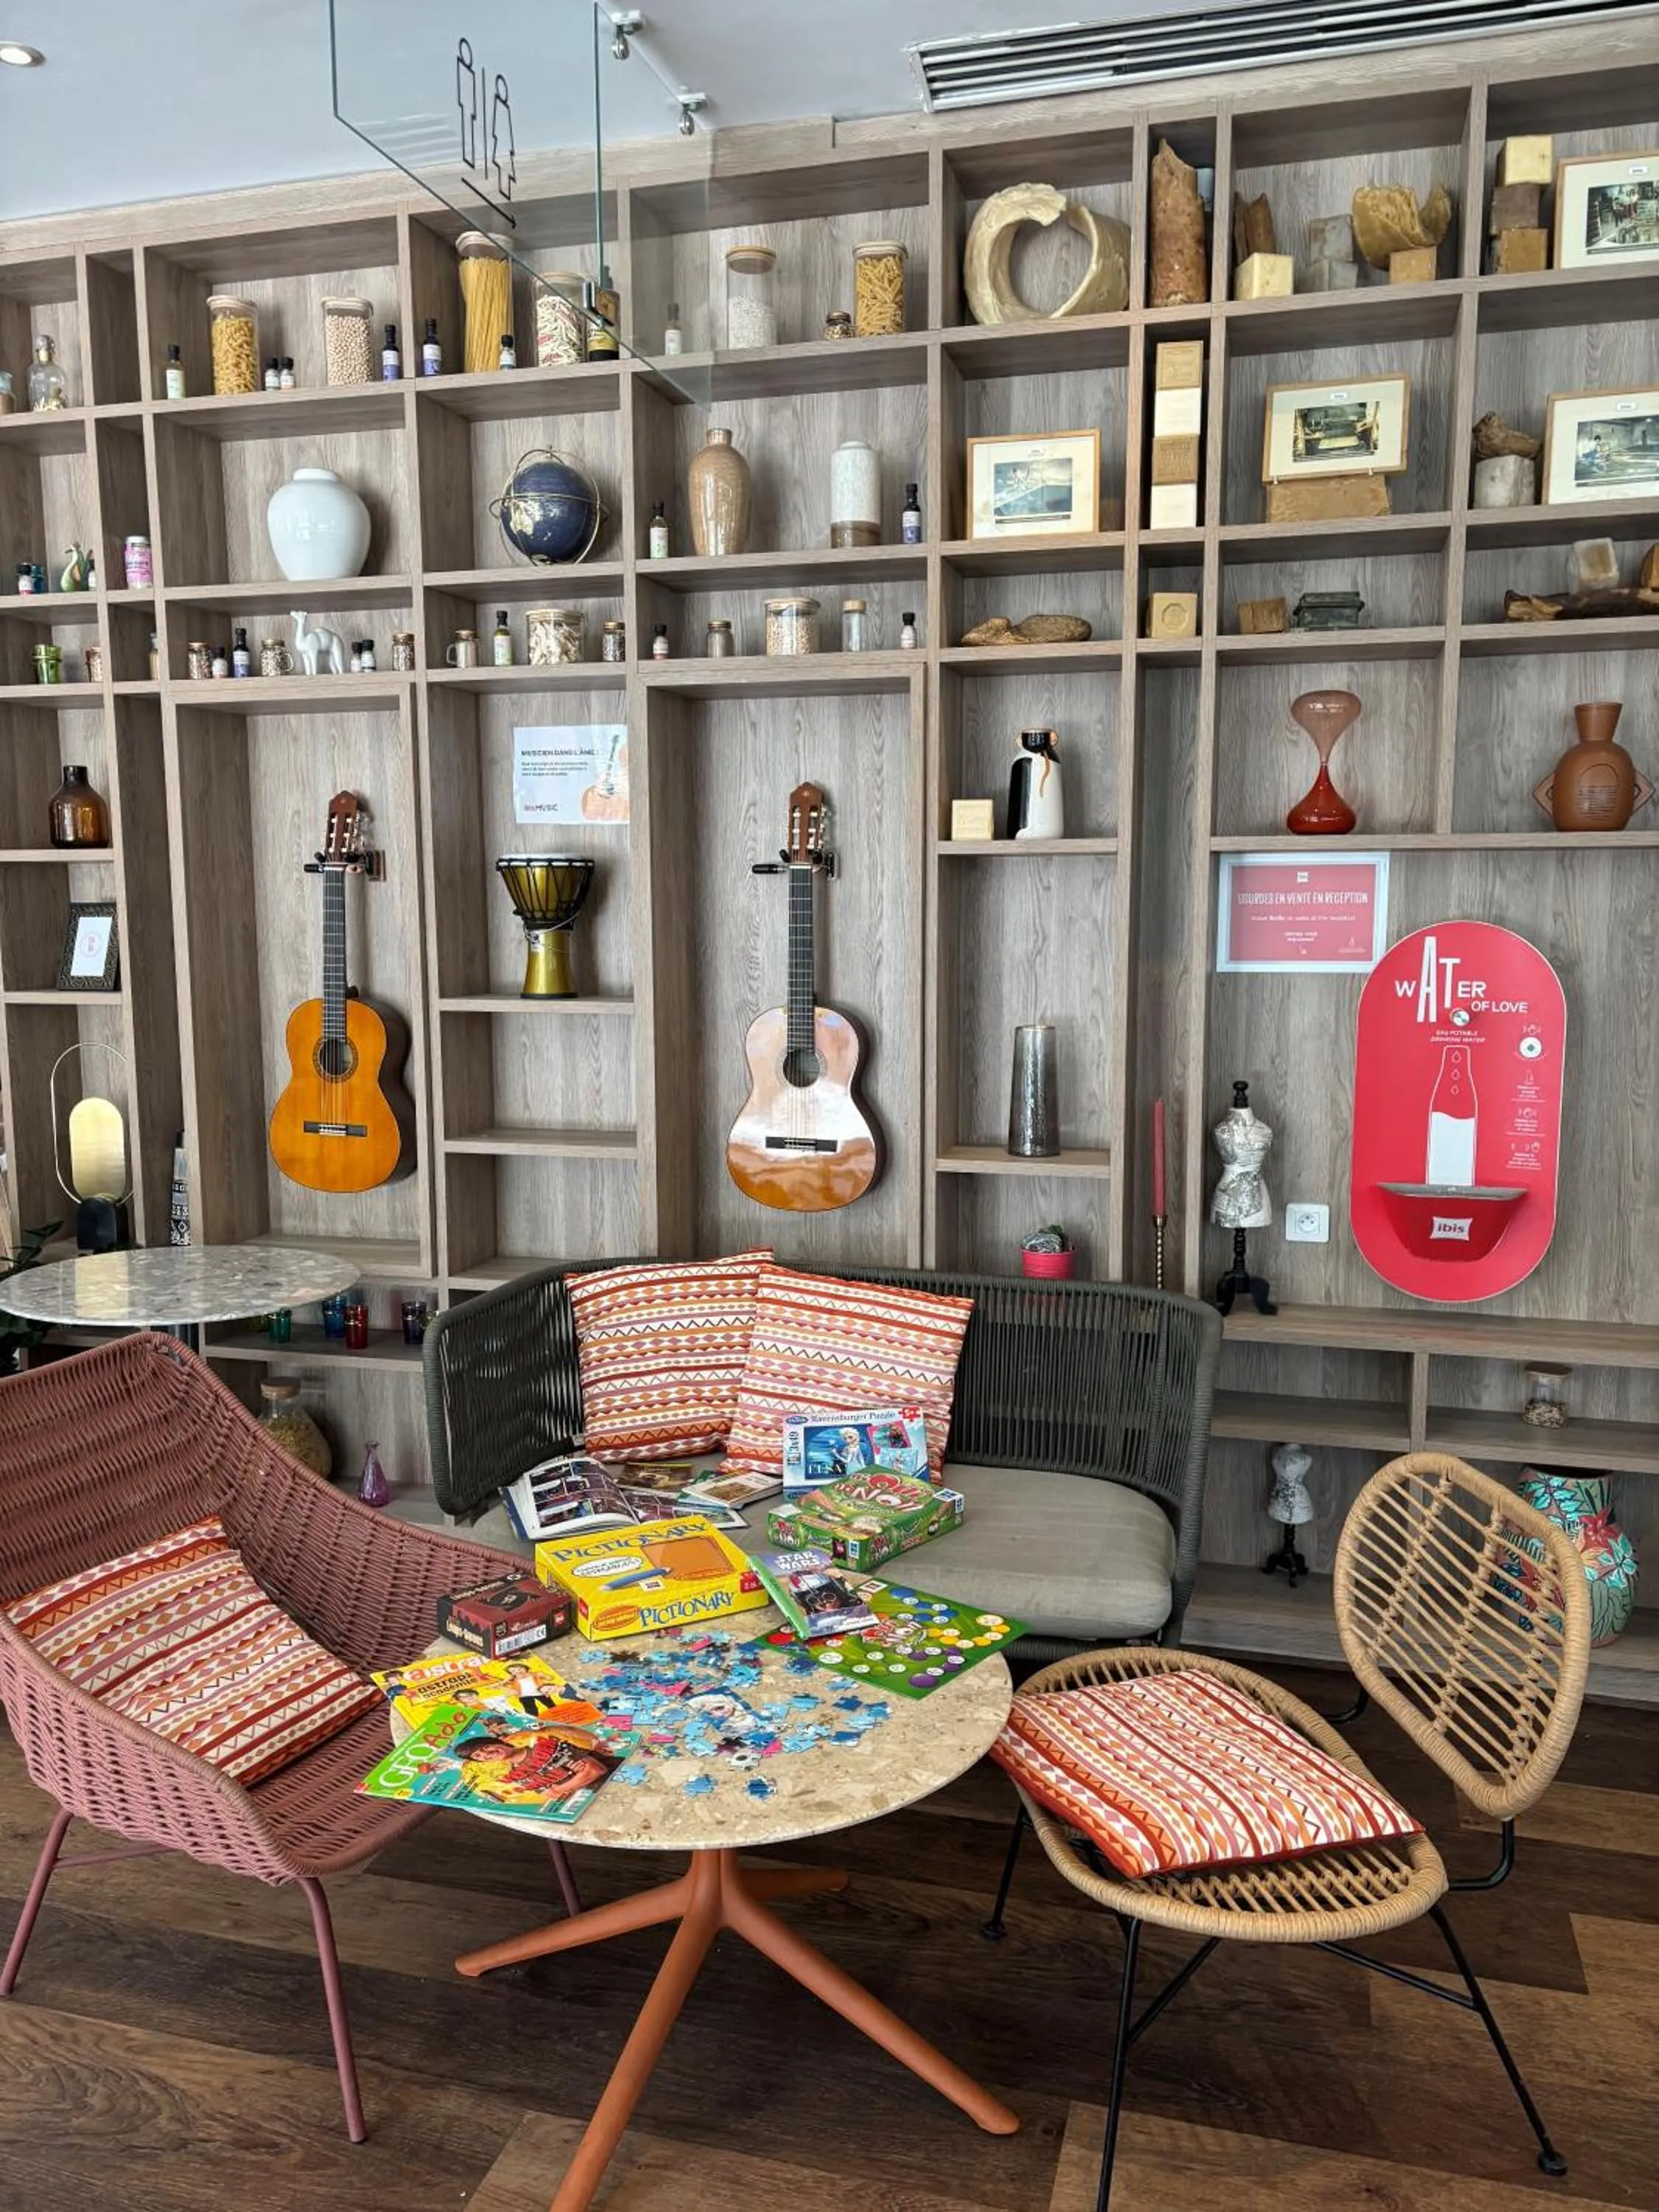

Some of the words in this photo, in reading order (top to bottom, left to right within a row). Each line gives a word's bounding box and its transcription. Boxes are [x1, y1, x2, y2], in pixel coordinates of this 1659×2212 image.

[1276, 892, 1286, 905] EN
[1287, 892, 1312, 904] VENTE
[1312, 891, 1324, 904] EN
[1394, 936, 1487, 1023] WATER
[1471, 1001, 1489, 1012] OF
[1492, 1001, 1529, 1014] LOVE
[1438, 1222, 1465, 1234] ibis
[811, 1412, 868, 1422] Ravensburger
[869, 1411, 896, 1419] Puzzle
[552, 1523, 706, 1562] PICTIONARY
[773, 1551, 817, 1562] STAR
[778, 1558, 821, 1570] WARS
[639, 1590, 735, 1627] PICTIONARY
[403, 1655, 489, 1681] astra
